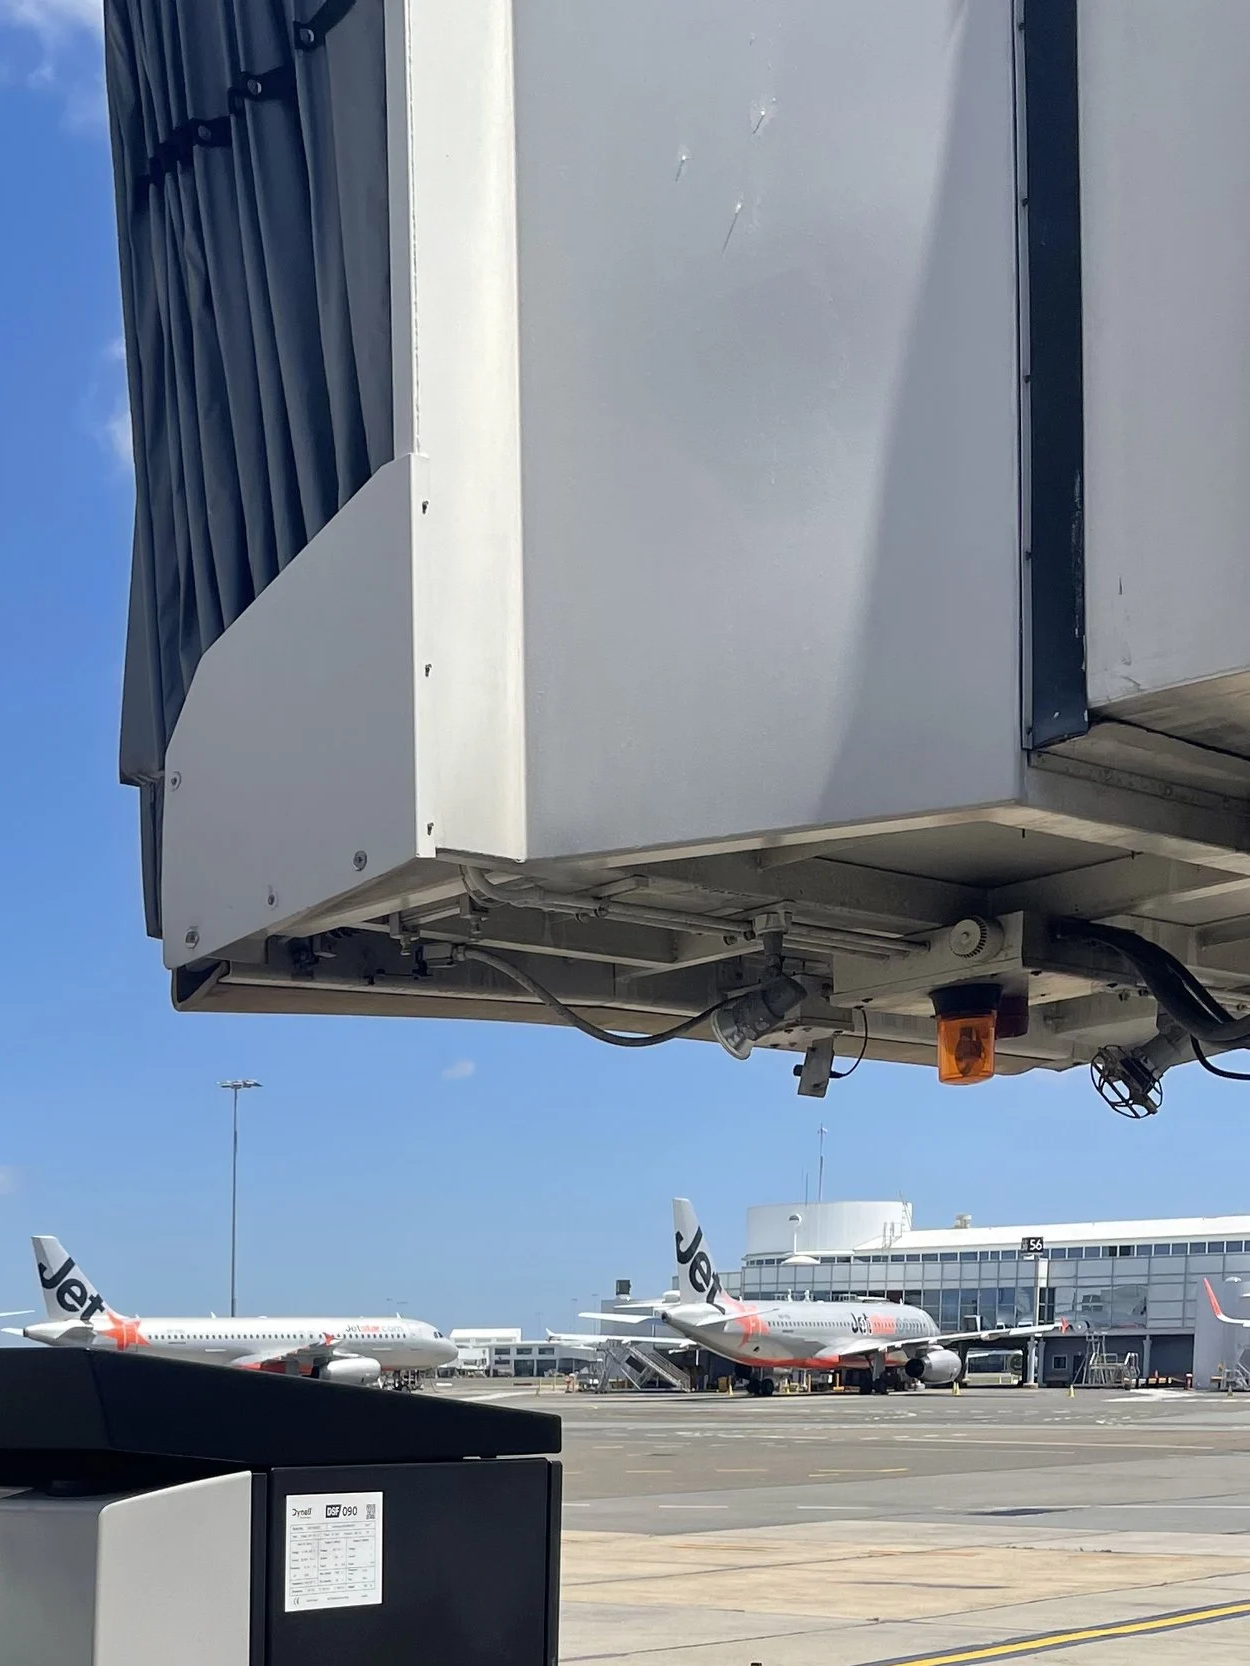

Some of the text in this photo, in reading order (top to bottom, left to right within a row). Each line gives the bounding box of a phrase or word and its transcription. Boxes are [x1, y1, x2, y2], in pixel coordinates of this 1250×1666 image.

[1029, 1239, 1043, 1251] 56
[675, 1225, 722, 1304] Jet
[38, 1257, 105, 1321] Jet
[326, 1505, 340, 1517] DSF
[342, 1506, 358, 1516] 090
